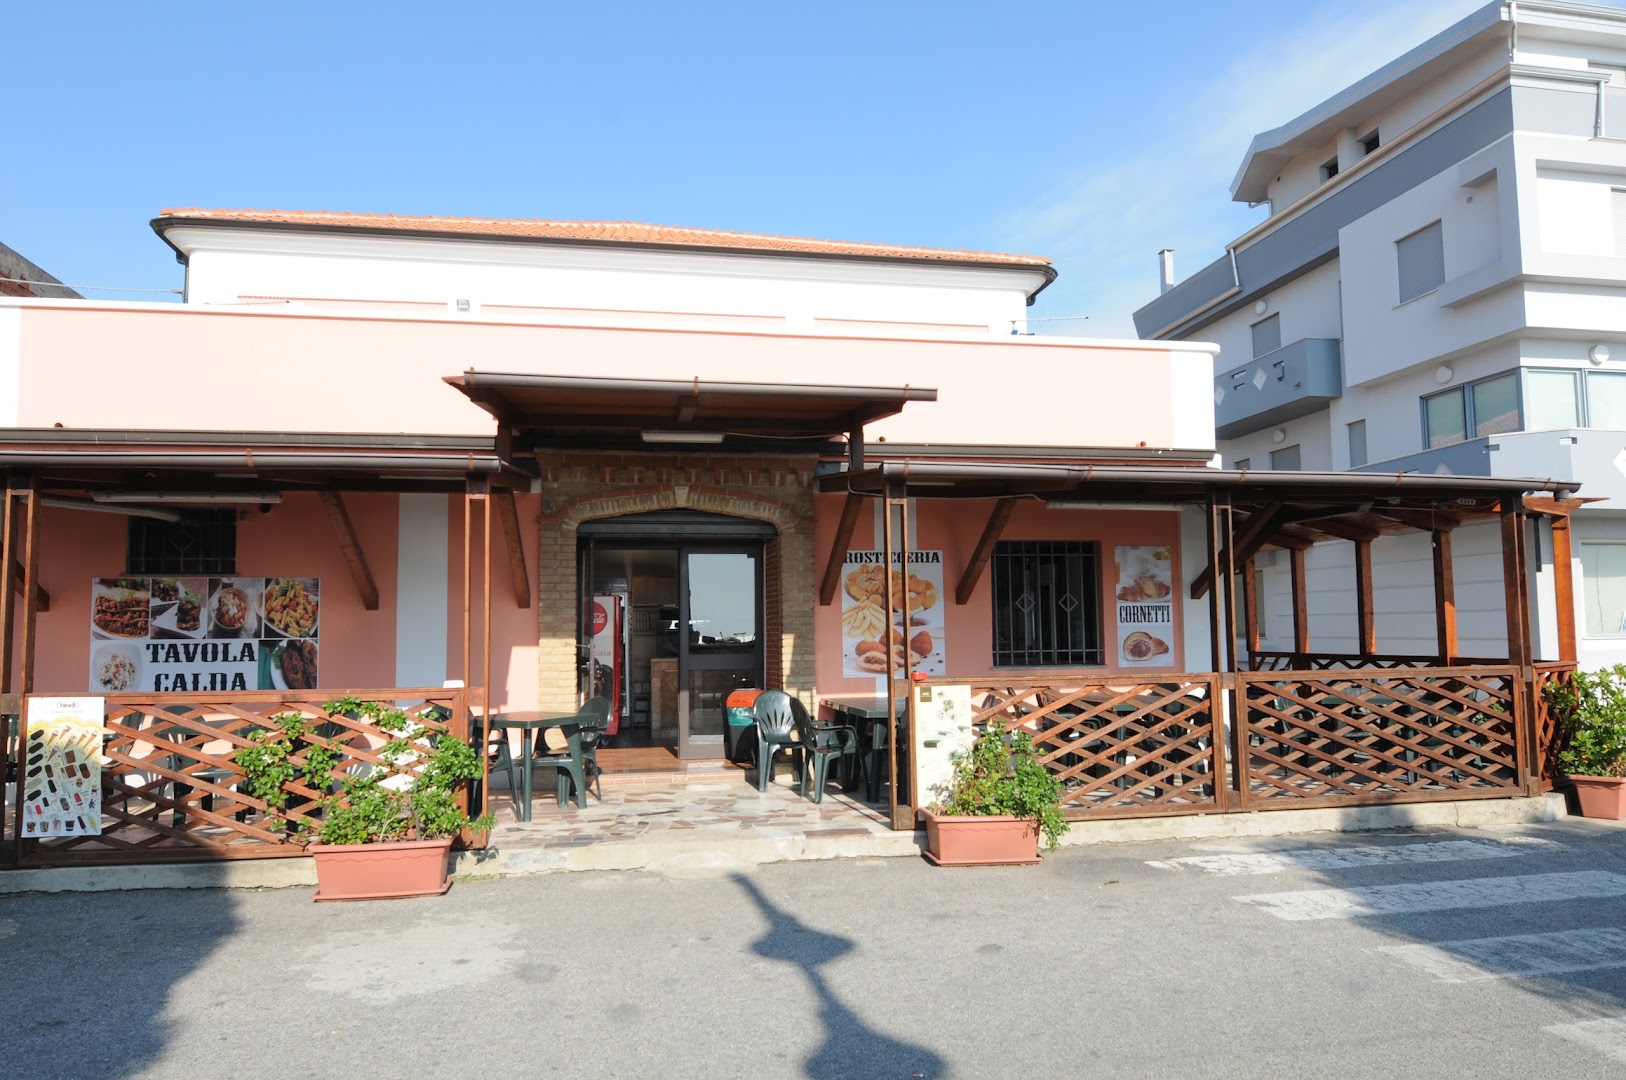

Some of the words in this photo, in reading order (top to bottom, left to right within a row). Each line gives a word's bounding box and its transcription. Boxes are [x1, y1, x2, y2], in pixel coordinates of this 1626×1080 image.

[845, 551, 941, 563] ROSTCCERIA
[1119, 605, 1170, 623] CORNETTI
[146, 642, 257, 663] TAVOLA
[154, 672, 247, 691] CALDA
